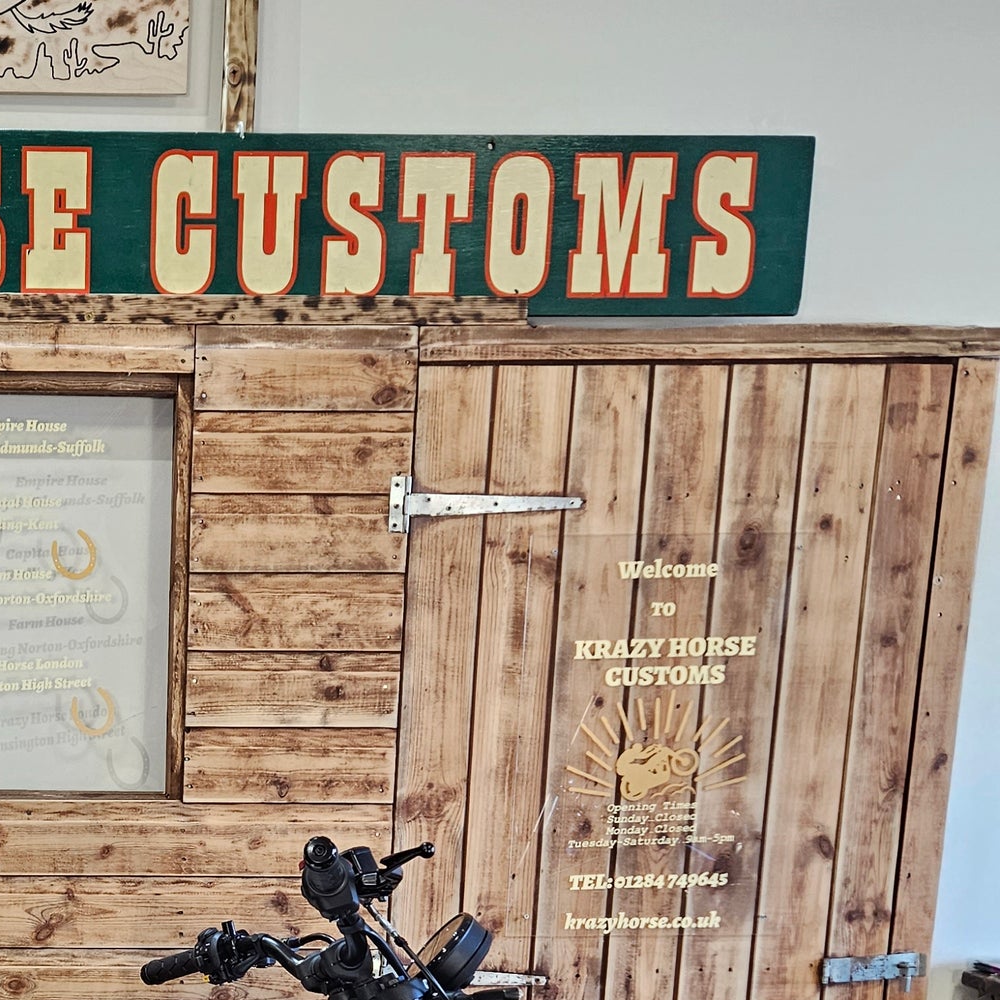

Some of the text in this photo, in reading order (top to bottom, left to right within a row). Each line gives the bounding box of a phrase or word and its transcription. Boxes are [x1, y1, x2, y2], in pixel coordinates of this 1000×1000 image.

[150, 148, 758, 298] CUSTOMS
[26, 418, 68, 433] House
[23, 497, 63, 509] House
[13, 569, 53, 582] House
[617, 559, 719, 580] Welcome
[573, 635, 757, 660] KRAZY HORSE
[35, 656, 84, 669] London
[604, 664, 727, 687] CUSTOMS
[21, 678, 54, 693] High
[54, 677, 93, 689] Street
[606, 801, 698, 815] Opening Times
[655, 812, 697, 822] Closed
[606, 824, 697, 837] Monday Closed
[568, 836, 680, 849] Tuesday-Saturday
[569, 871, 729, 891] TEL: 01284 749645
[564, 910, 722, 935] krazyhorse.co.uk
